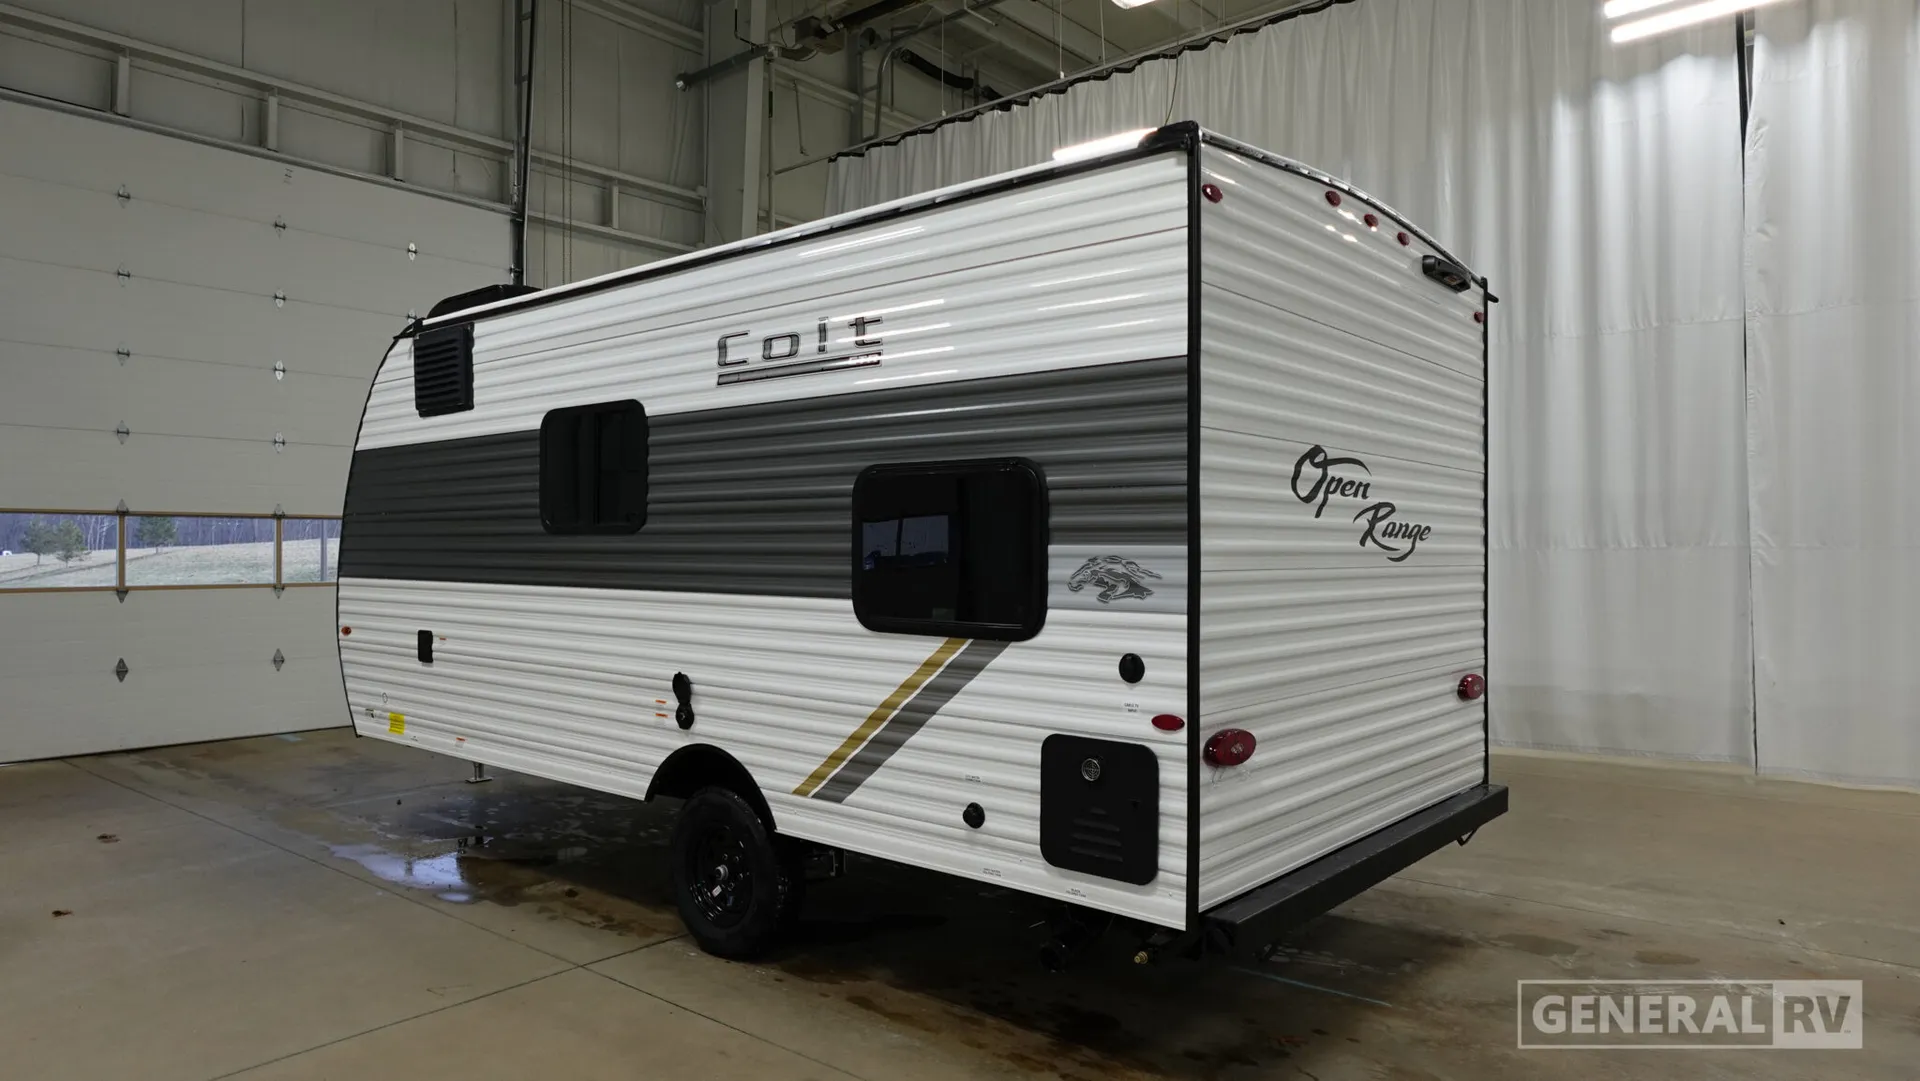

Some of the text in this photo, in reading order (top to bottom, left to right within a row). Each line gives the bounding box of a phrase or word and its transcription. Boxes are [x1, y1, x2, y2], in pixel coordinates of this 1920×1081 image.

[717, 316, 883, 367] Colt
[1291, 445, 1372, 519] Open
[1353, 502, 1432, 562] Range
